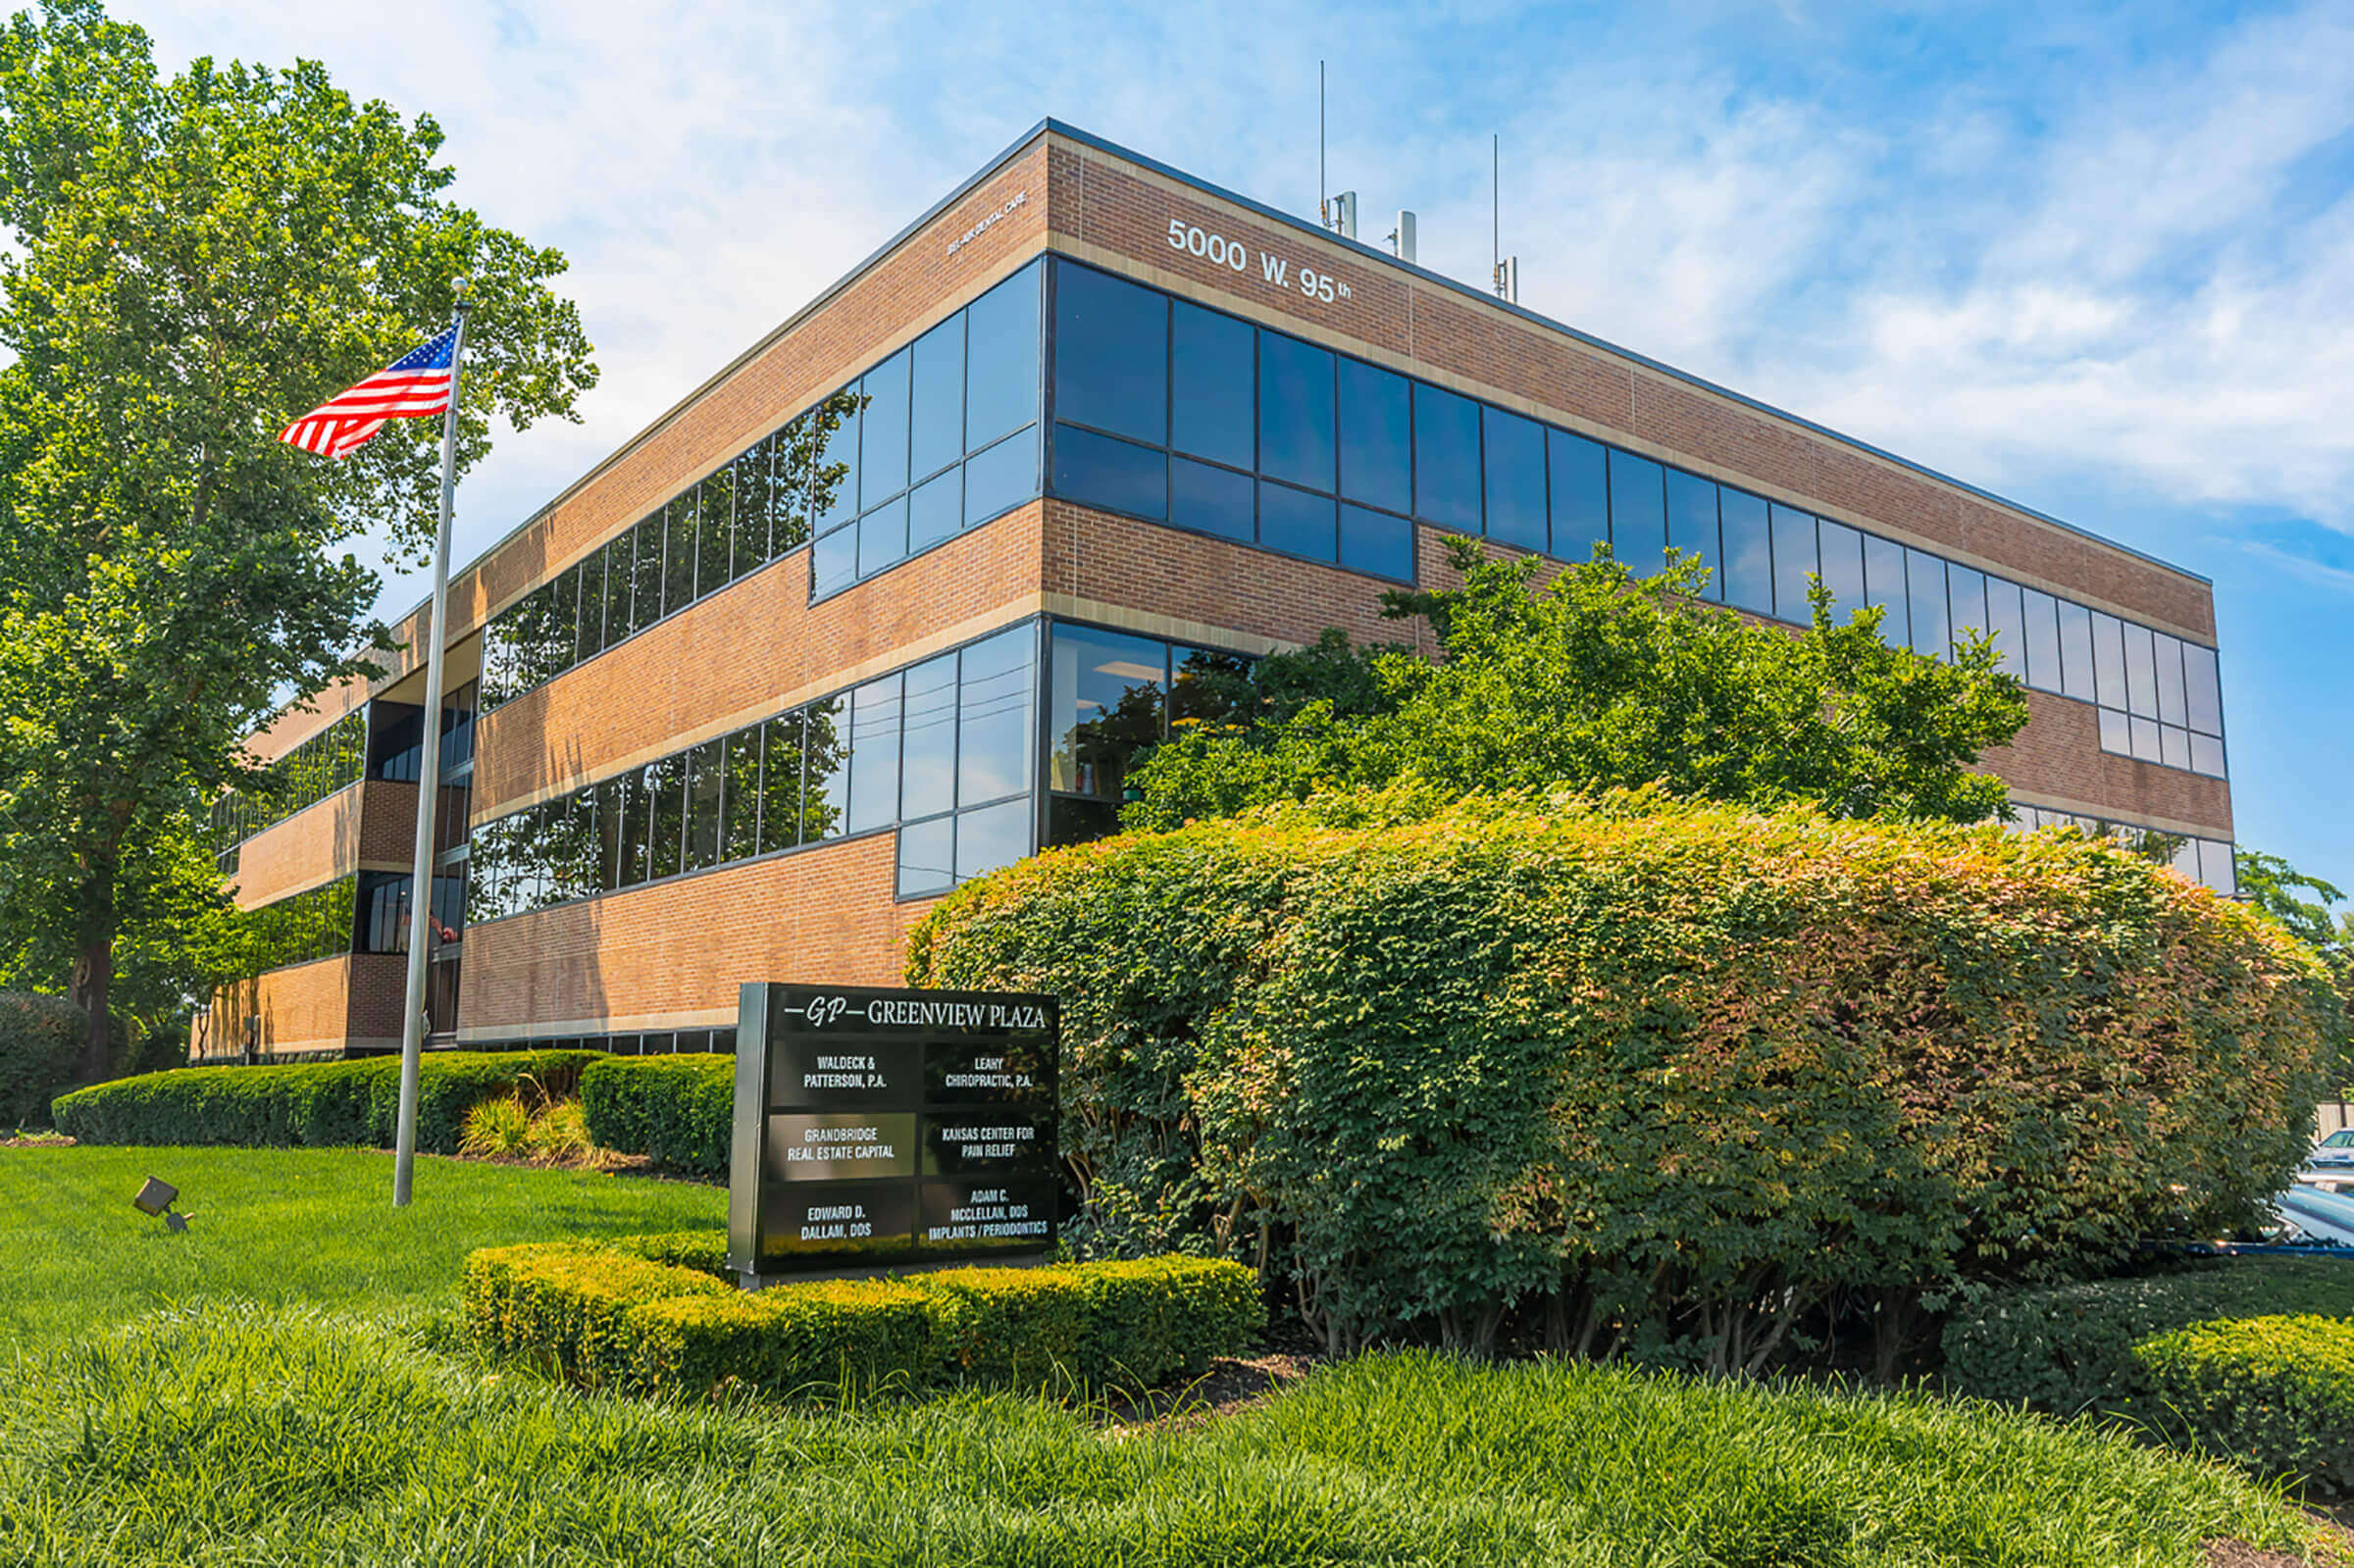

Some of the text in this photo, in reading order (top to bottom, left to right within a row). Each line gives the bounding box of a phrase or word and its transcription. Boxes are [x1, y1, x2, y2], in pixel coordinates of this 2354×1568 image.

[976, 208, 1004, 235] DENTAL
[1004, 190, 1027, 214] CARE
[1167, 218, 1352, 303] 5000 W. 95th
[868, 1000, 985, 1026] GREENVIEW
[990, 1005, 1047, 1028] PLAZA
[817, 1056, 875, 1070] WALDECK &
[974, 1058, 1003, 1071] LEAHY
[804, 1074, 887, 1088] PATTERSON, P.A.
[946, 1074, 1034, 1087] CHIROPRACTIC, P.A.
[805, 1128, 878, 1142] GRANDBRIDGE
[943, 1127, 1035, 1140] KANSAS CENTER FOR
[788, 1144, 895, 1161] REAL ESTATE CAPITAL
[962, 1143, 1015, 1157] PAIN RELIEF
[971, 1189, 1009, 1203] ADAM C.
[808, 1204, 866, 1221] EDWARD D.
[951, 1204, 1028, 1222] MCCLELLAN, DDS
[801, 1222, 872, 1240] DALLAM, DDS
[929, 1225, 976, 1240] IMPLANTS
[983, 1221, 1048, 1237] PERIODONTICS
